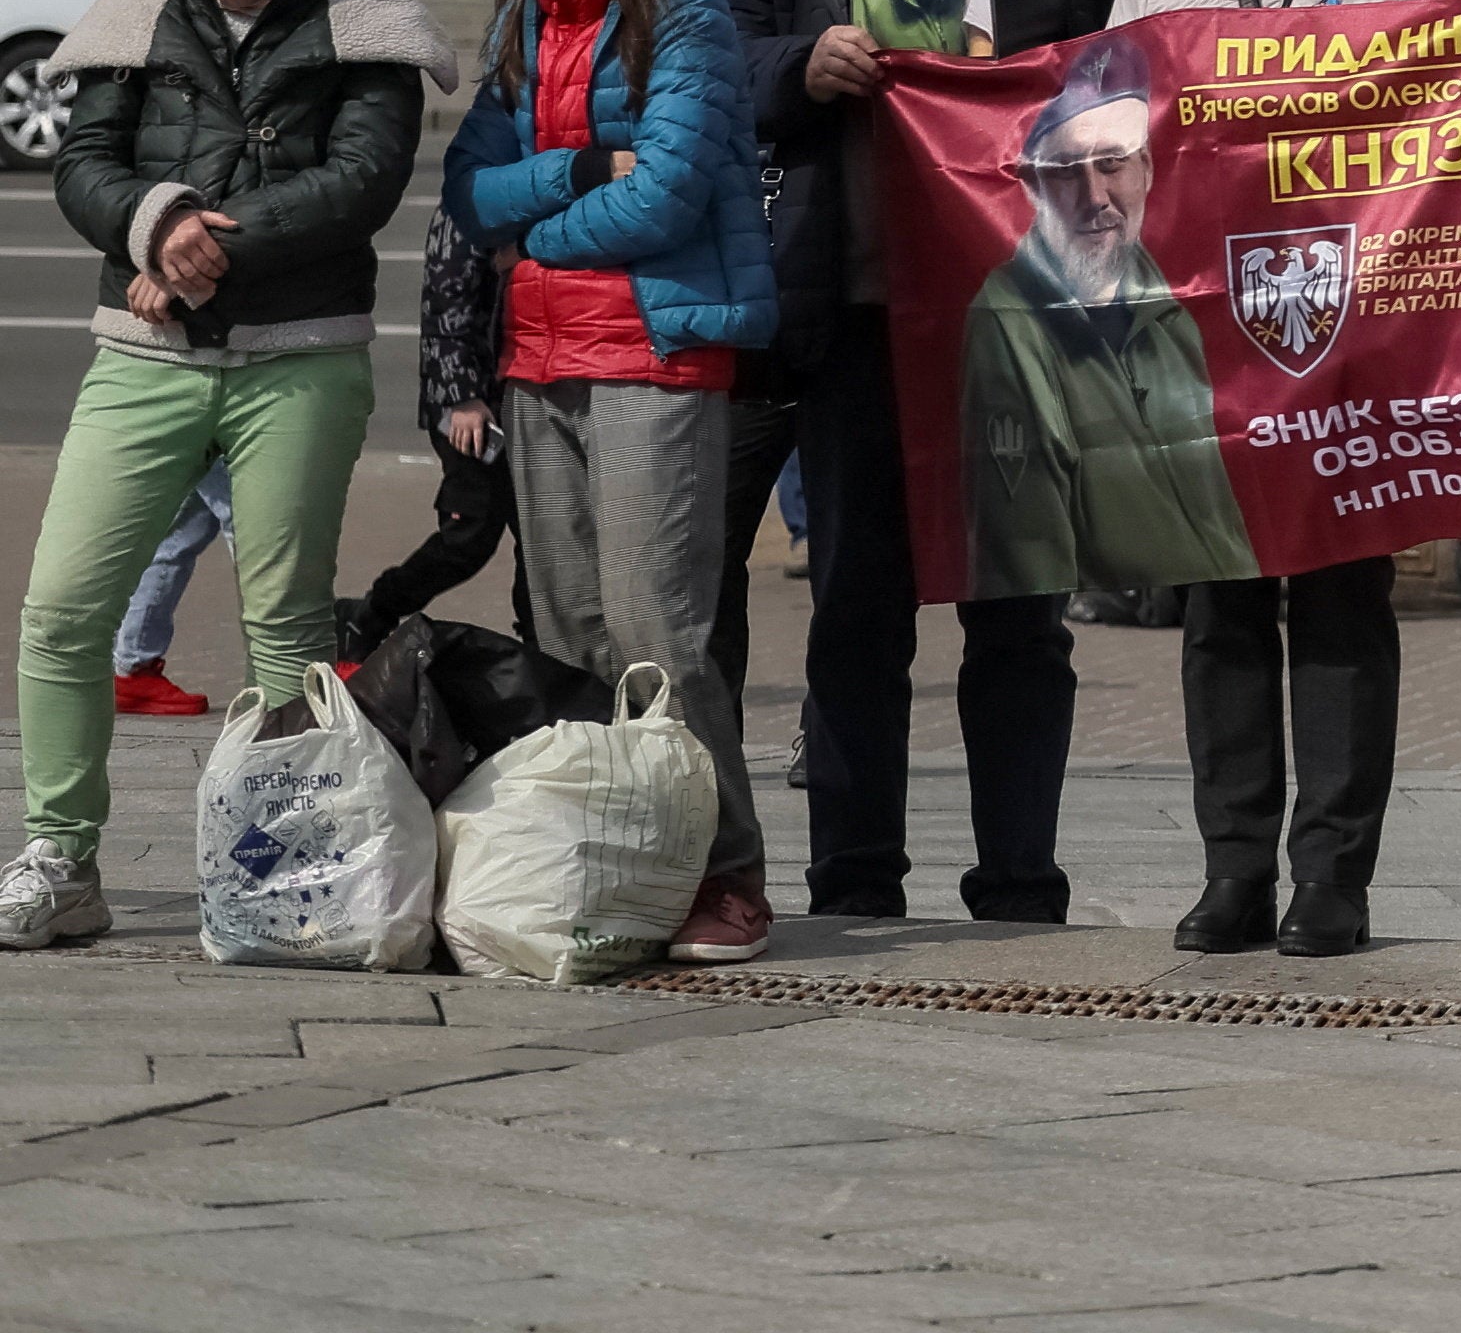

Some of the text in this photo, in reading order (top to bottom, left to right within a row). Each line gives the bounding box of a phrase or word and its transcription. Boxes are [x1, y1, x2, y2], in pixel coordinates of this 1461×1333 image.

[1178, 90, 1340, 126] В'ячеслав
[1359, 233, 1384, 252] 82
[1358, 300, 1367, 317] 1
[1247, 398, 1382, 447] ЗНИК
[243, 771, 343, 794] ПЕРЕВІРЯЄМО
[265, 795, 316, 816] ЯКІСТЬ
[234, 844, 283, 860] ПРЕМІЯ
